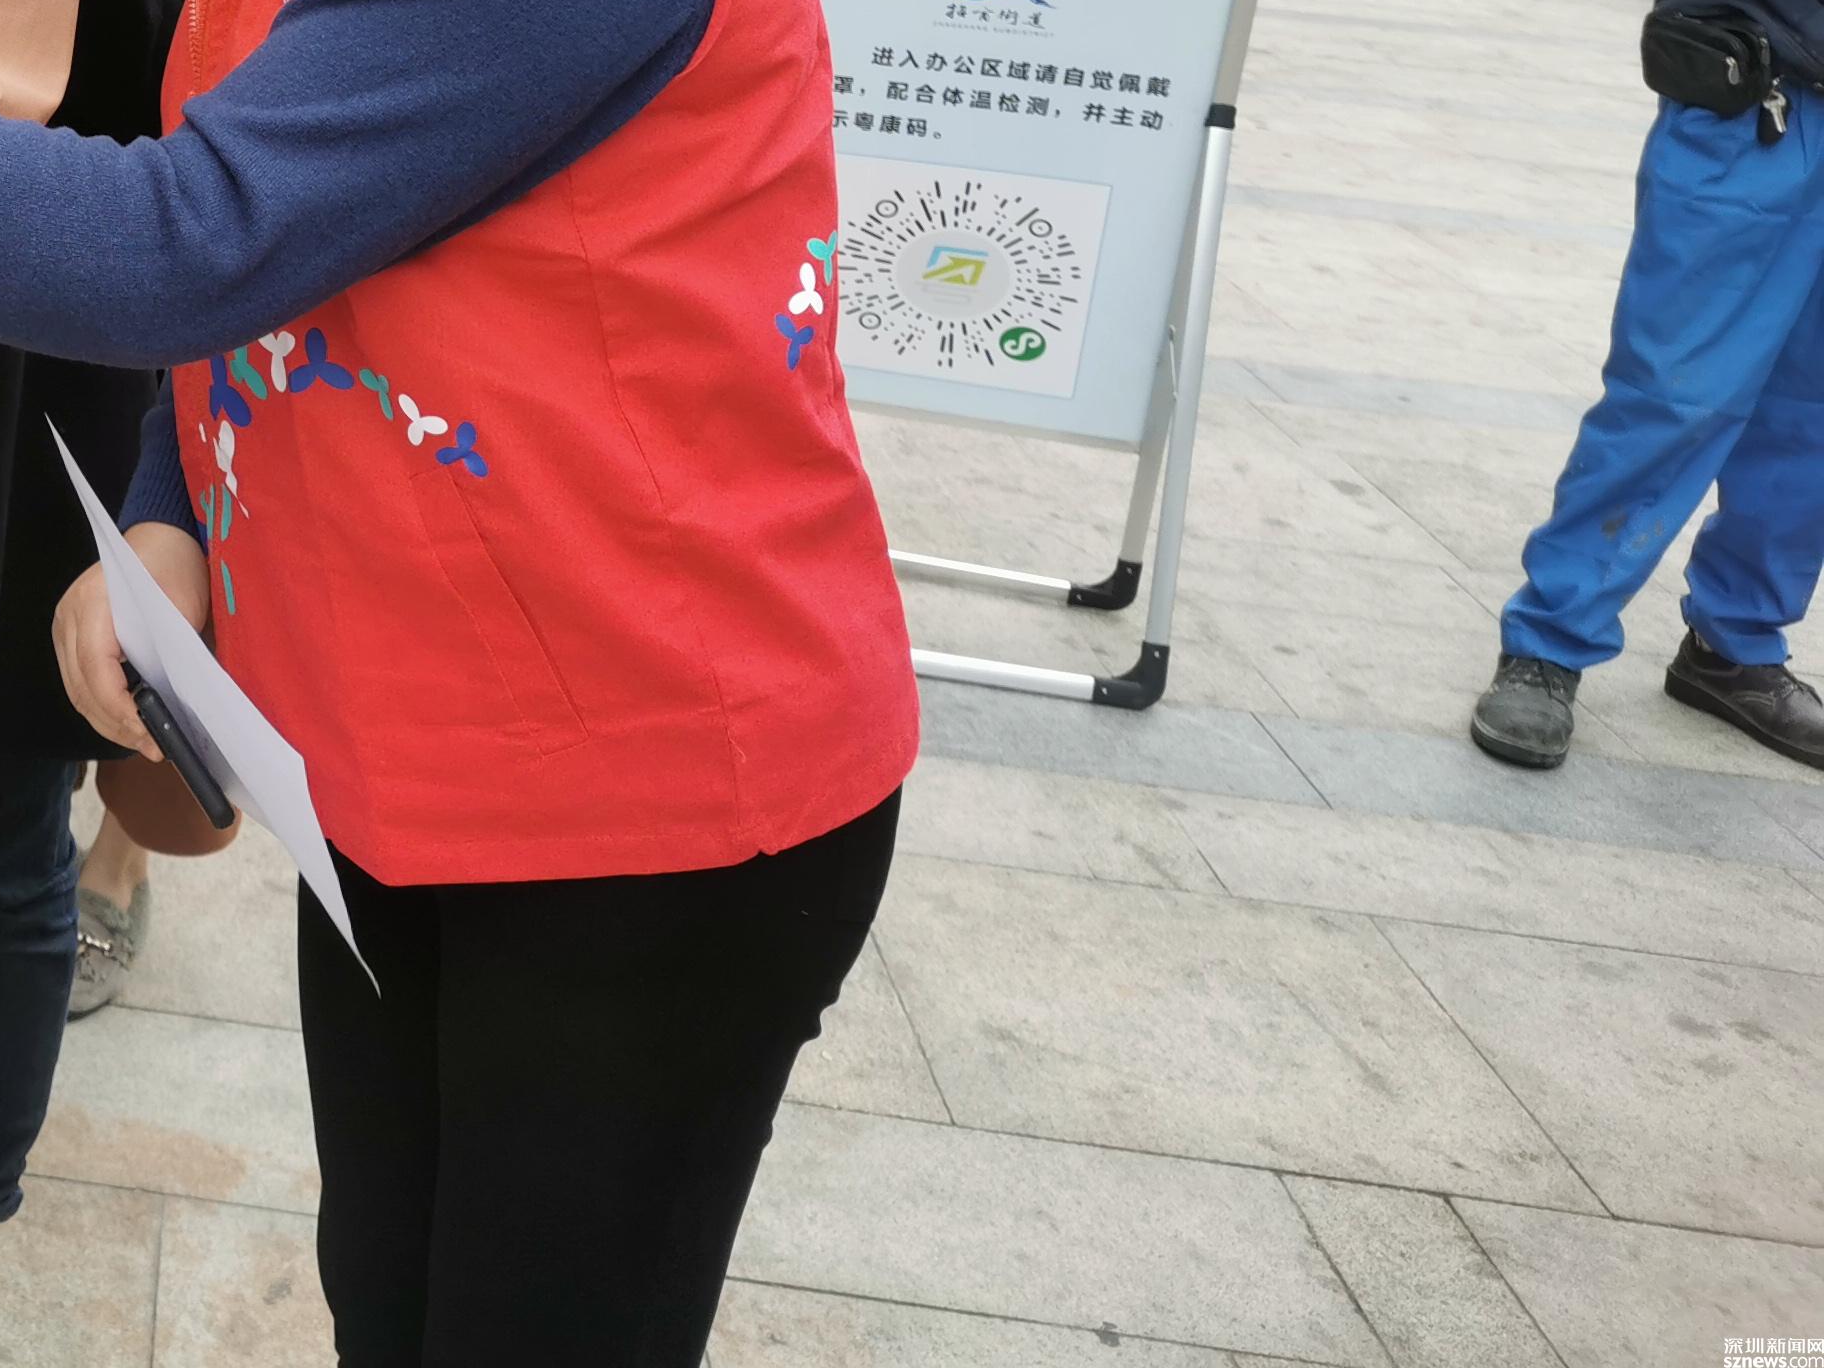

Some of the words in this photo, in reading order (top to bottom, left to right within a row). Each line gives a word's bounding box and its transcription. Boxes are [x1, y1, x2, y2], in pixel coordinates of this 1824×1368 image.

[870, 45, 1172, 98] 进入办公区域请自觉佩戴
